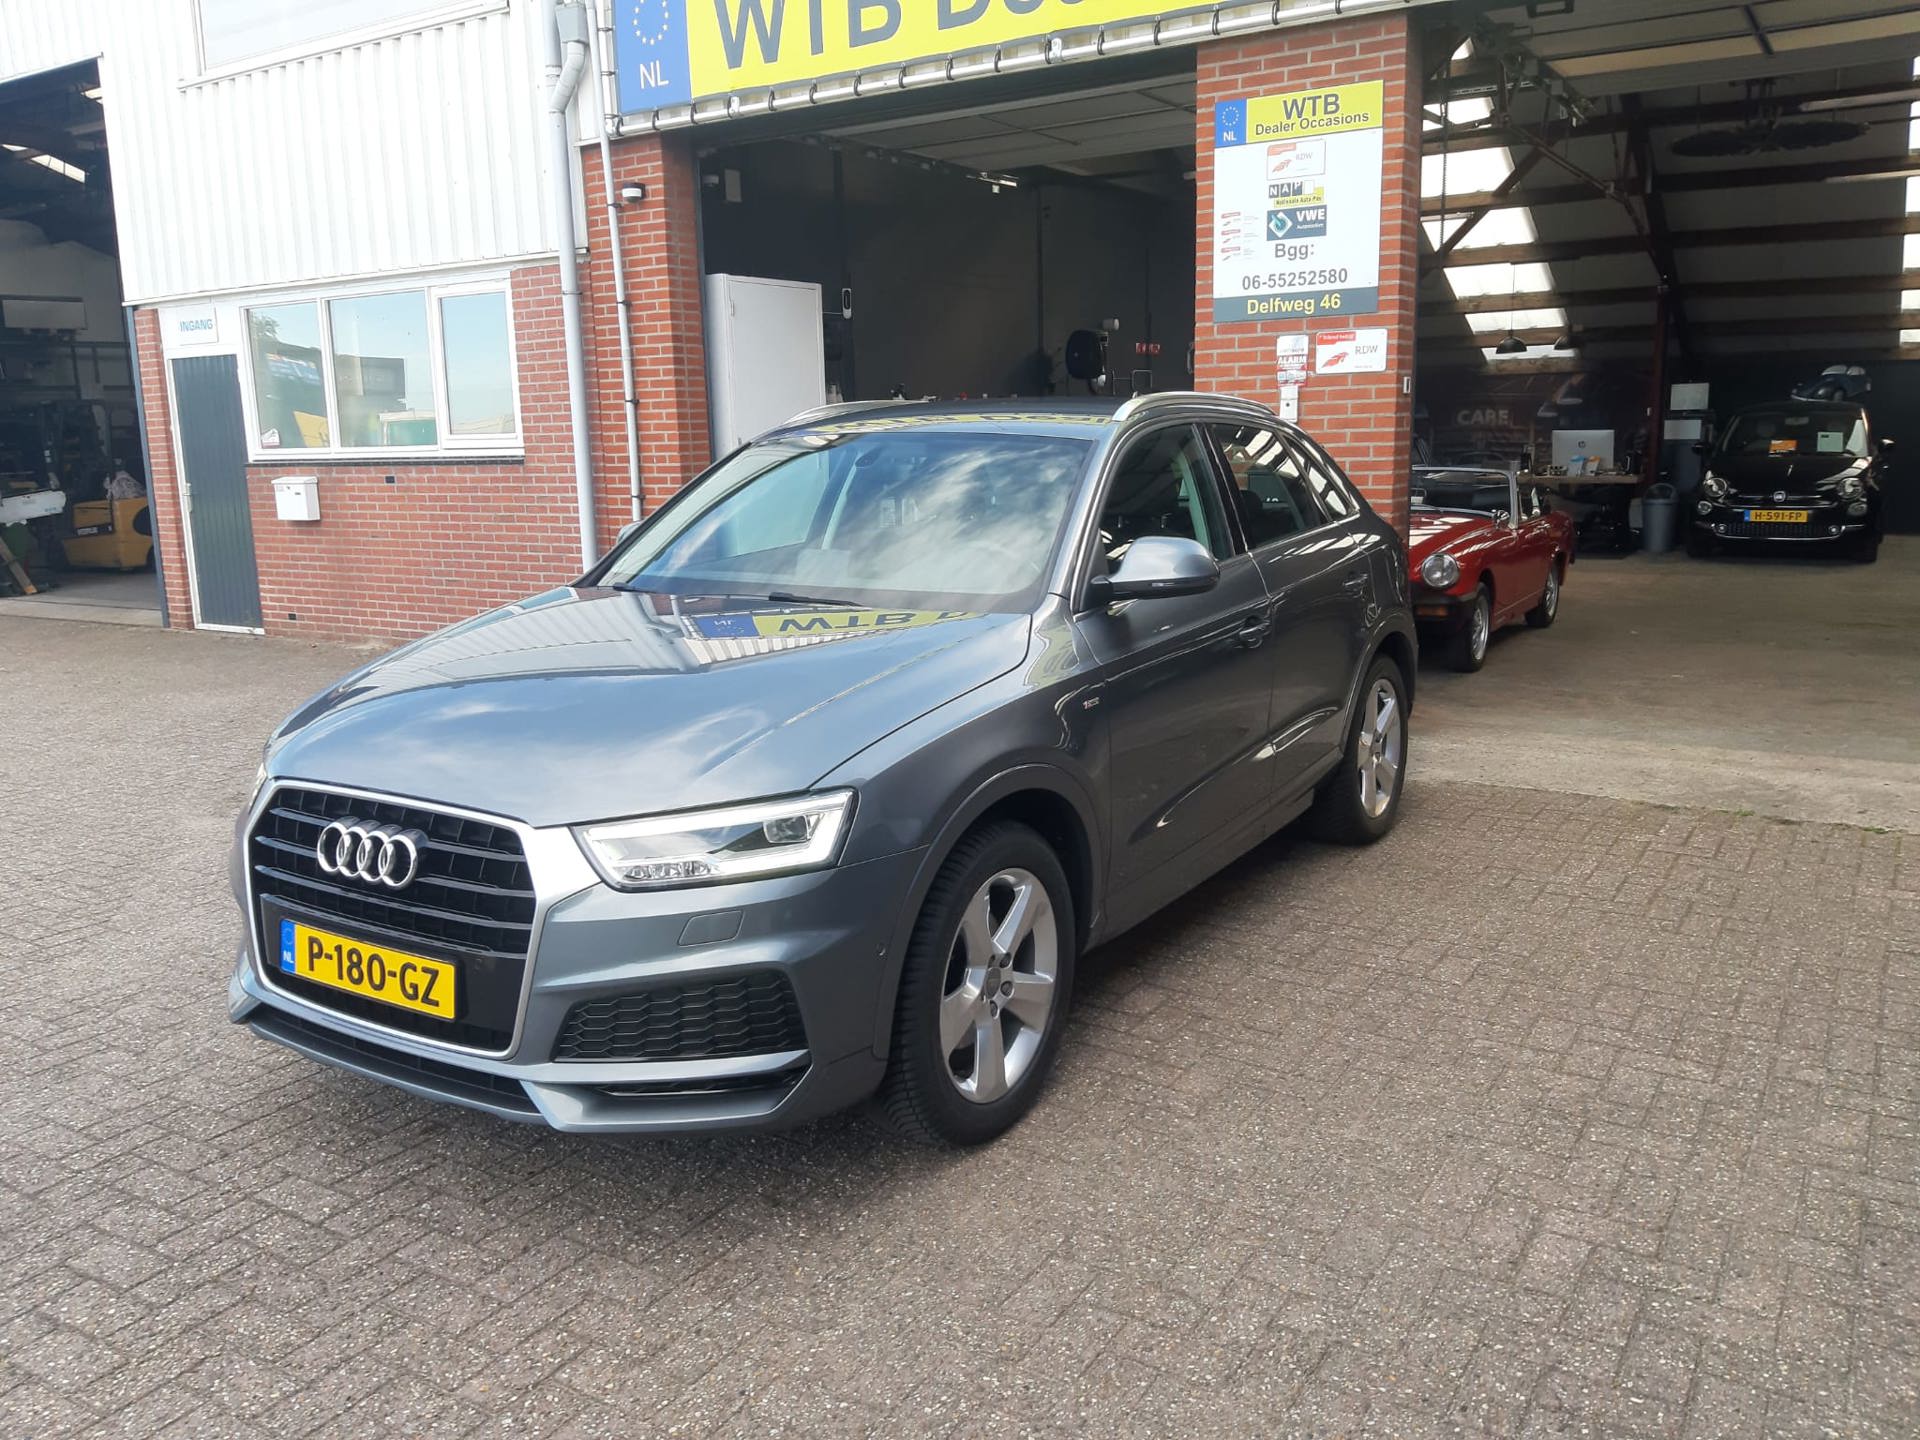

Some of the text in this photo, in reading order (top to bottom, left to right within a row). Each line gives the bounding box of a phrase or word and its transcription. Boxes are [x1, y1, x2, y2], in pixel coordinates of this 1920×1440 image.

[640, 60, 669, 89] NL
[1283, 93, 1341, 120] WTB
[1255, 111, 1369, 135] Dealer Occasions
[1223, 132, 1237, 142] NL
[1269, 182, 1302, 198] NAP
[1296, 208, 1326, 222] VWE
[1274, 243, 1315, 261] Bgg:
[1242, 268, 1348, 291] 06-55252580
[1247, 293, 1341, 315] Delfweg 46
[180, 318, 214, 332] INGANG
[1355, 345, 1378, 355] RDW
[1278, 354, 1307, 365] ALARM
[1457, 409, 1510, 425] CARE
[1754, 511, 1803, 521] H-591-FP
[308, 935, 440, 1008] P-180-GZ
